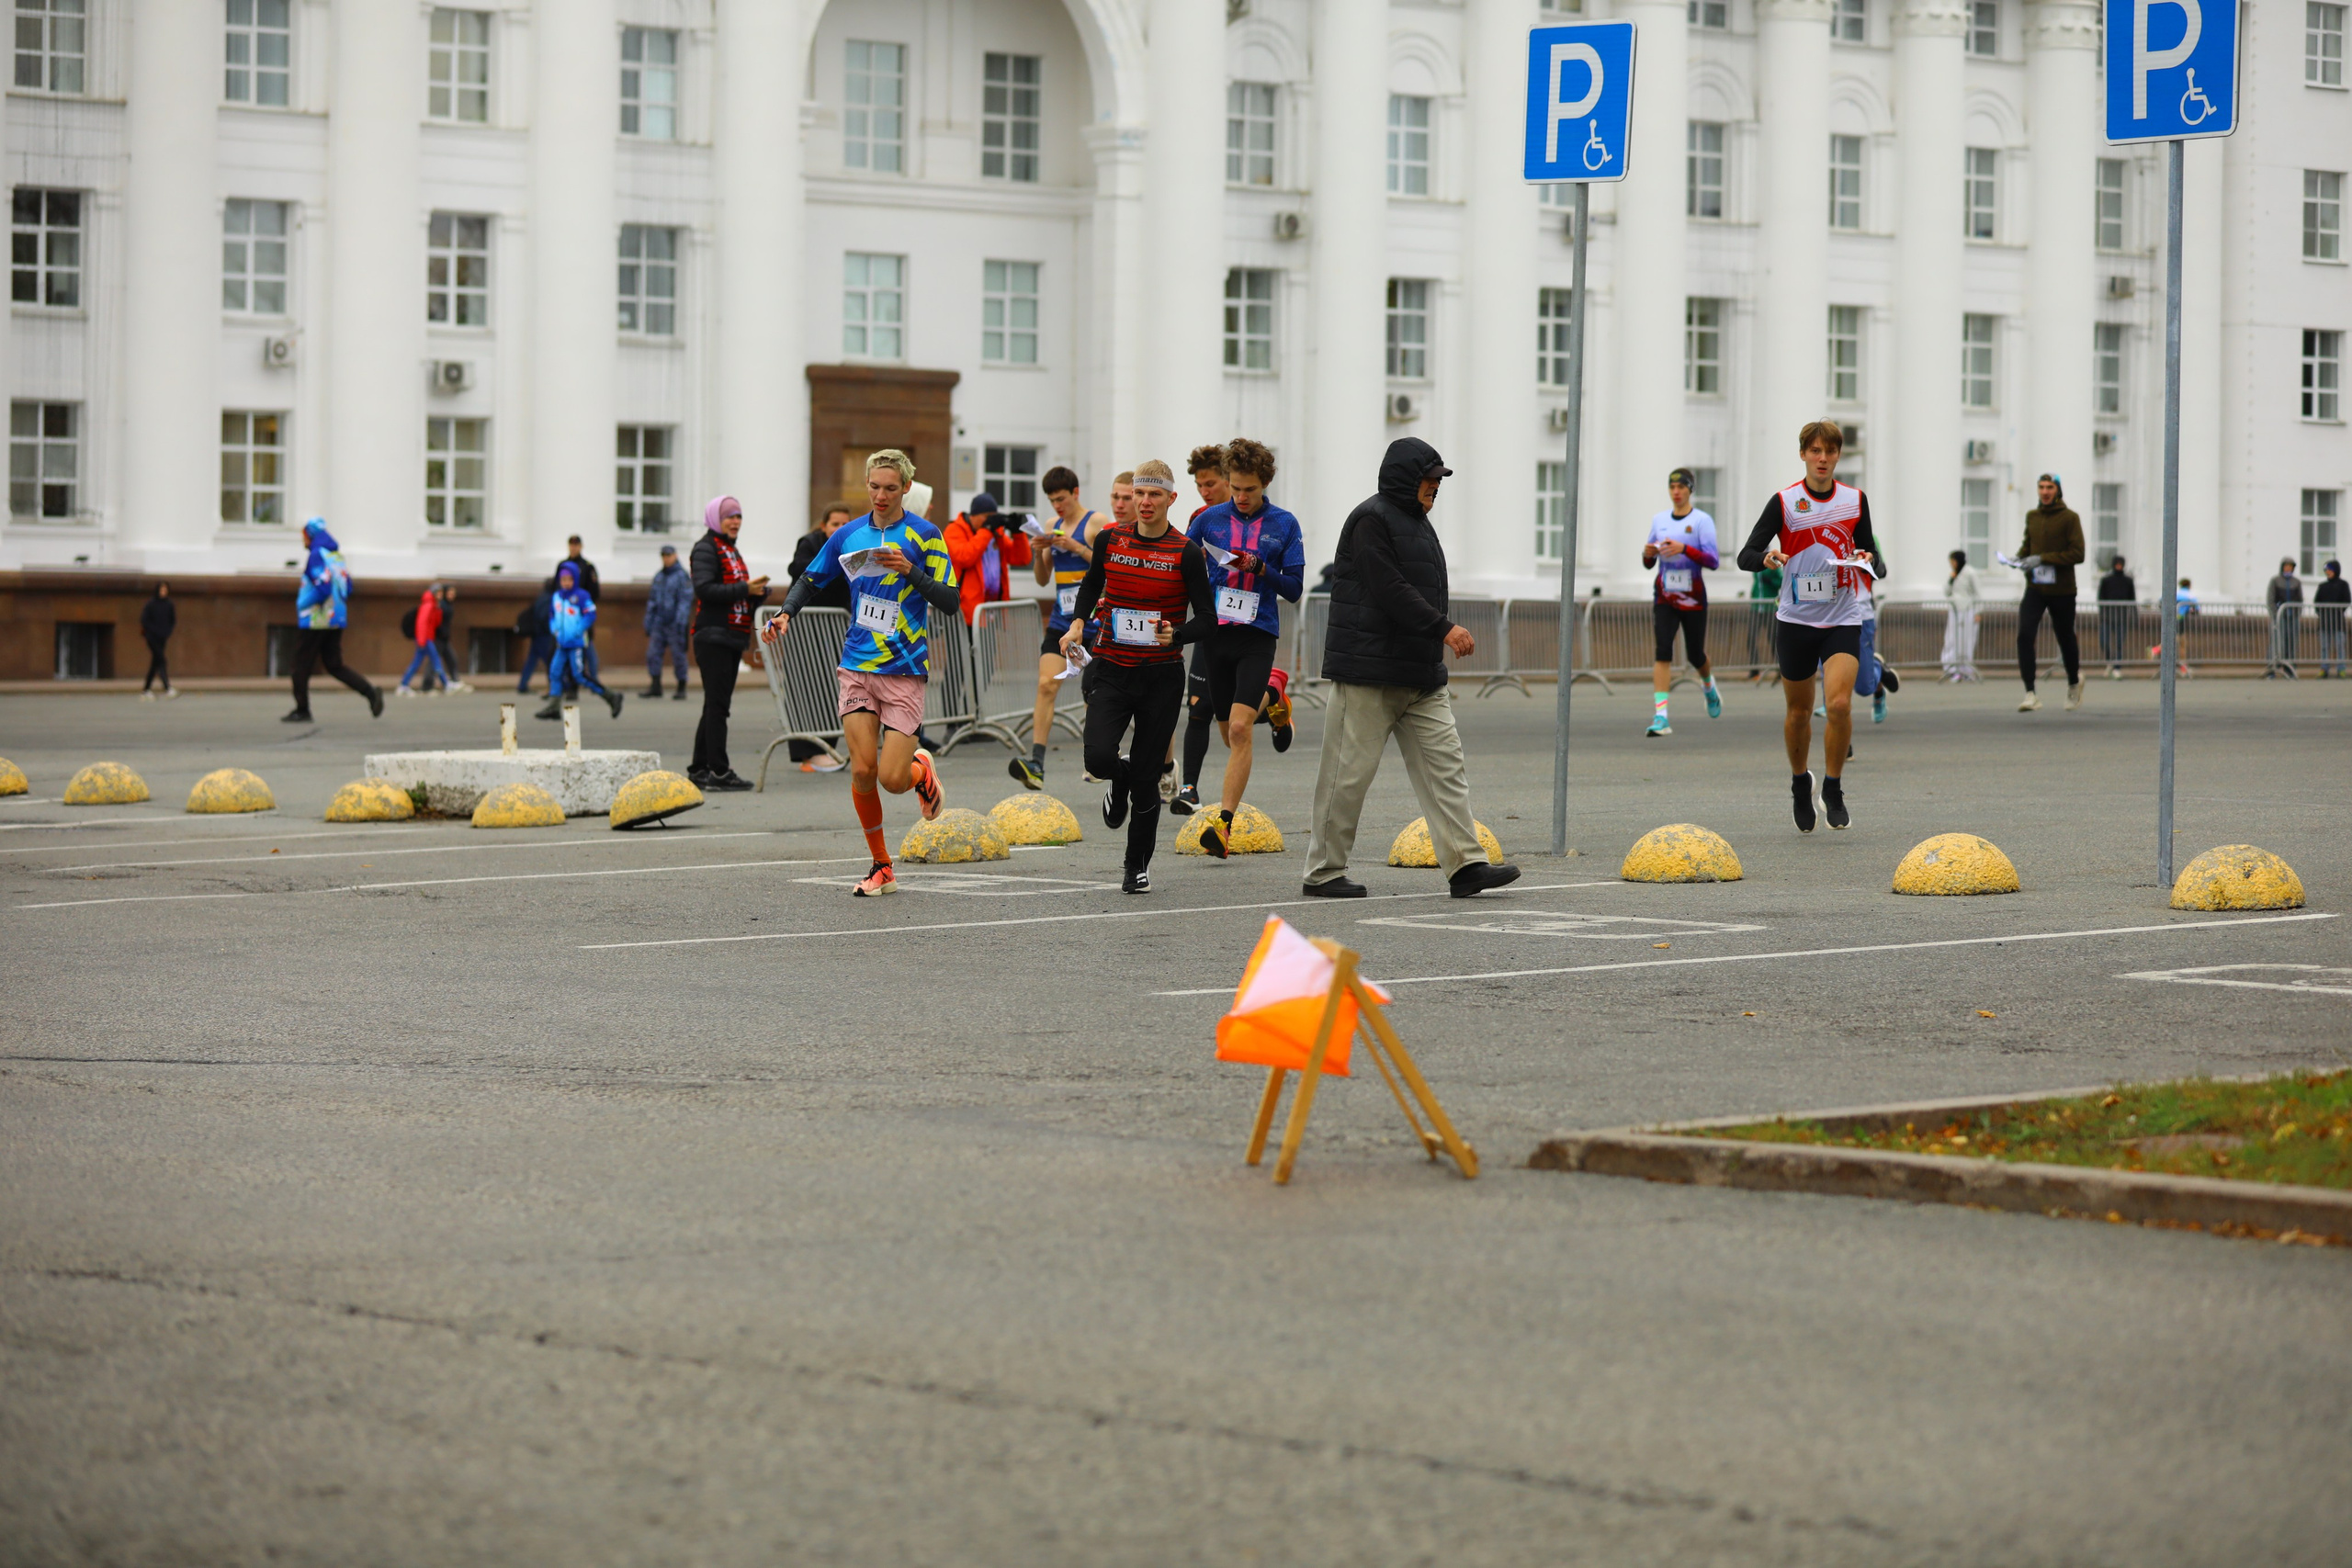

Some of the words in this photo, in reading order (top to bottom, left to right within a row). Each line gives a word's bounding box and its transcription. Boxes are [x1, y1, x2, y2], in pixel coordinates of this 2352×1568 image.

[2133, 0, 2202, 119] P
[1545, 42, 1604, 163] P
[1822, 528, 1840, 544] Run
[1110, 552, 1139, 567] NORD
[1143, 558, 1175, 571] WEST
[1669, 575, 1682, 583] 9.1
[1807, 581, 1823, 592] 1.1
[1226, 596, 1244, 610] 2.1
[863, 604, 886, 621] 11.1
[1125, 618, 1145, 632] 3.1
